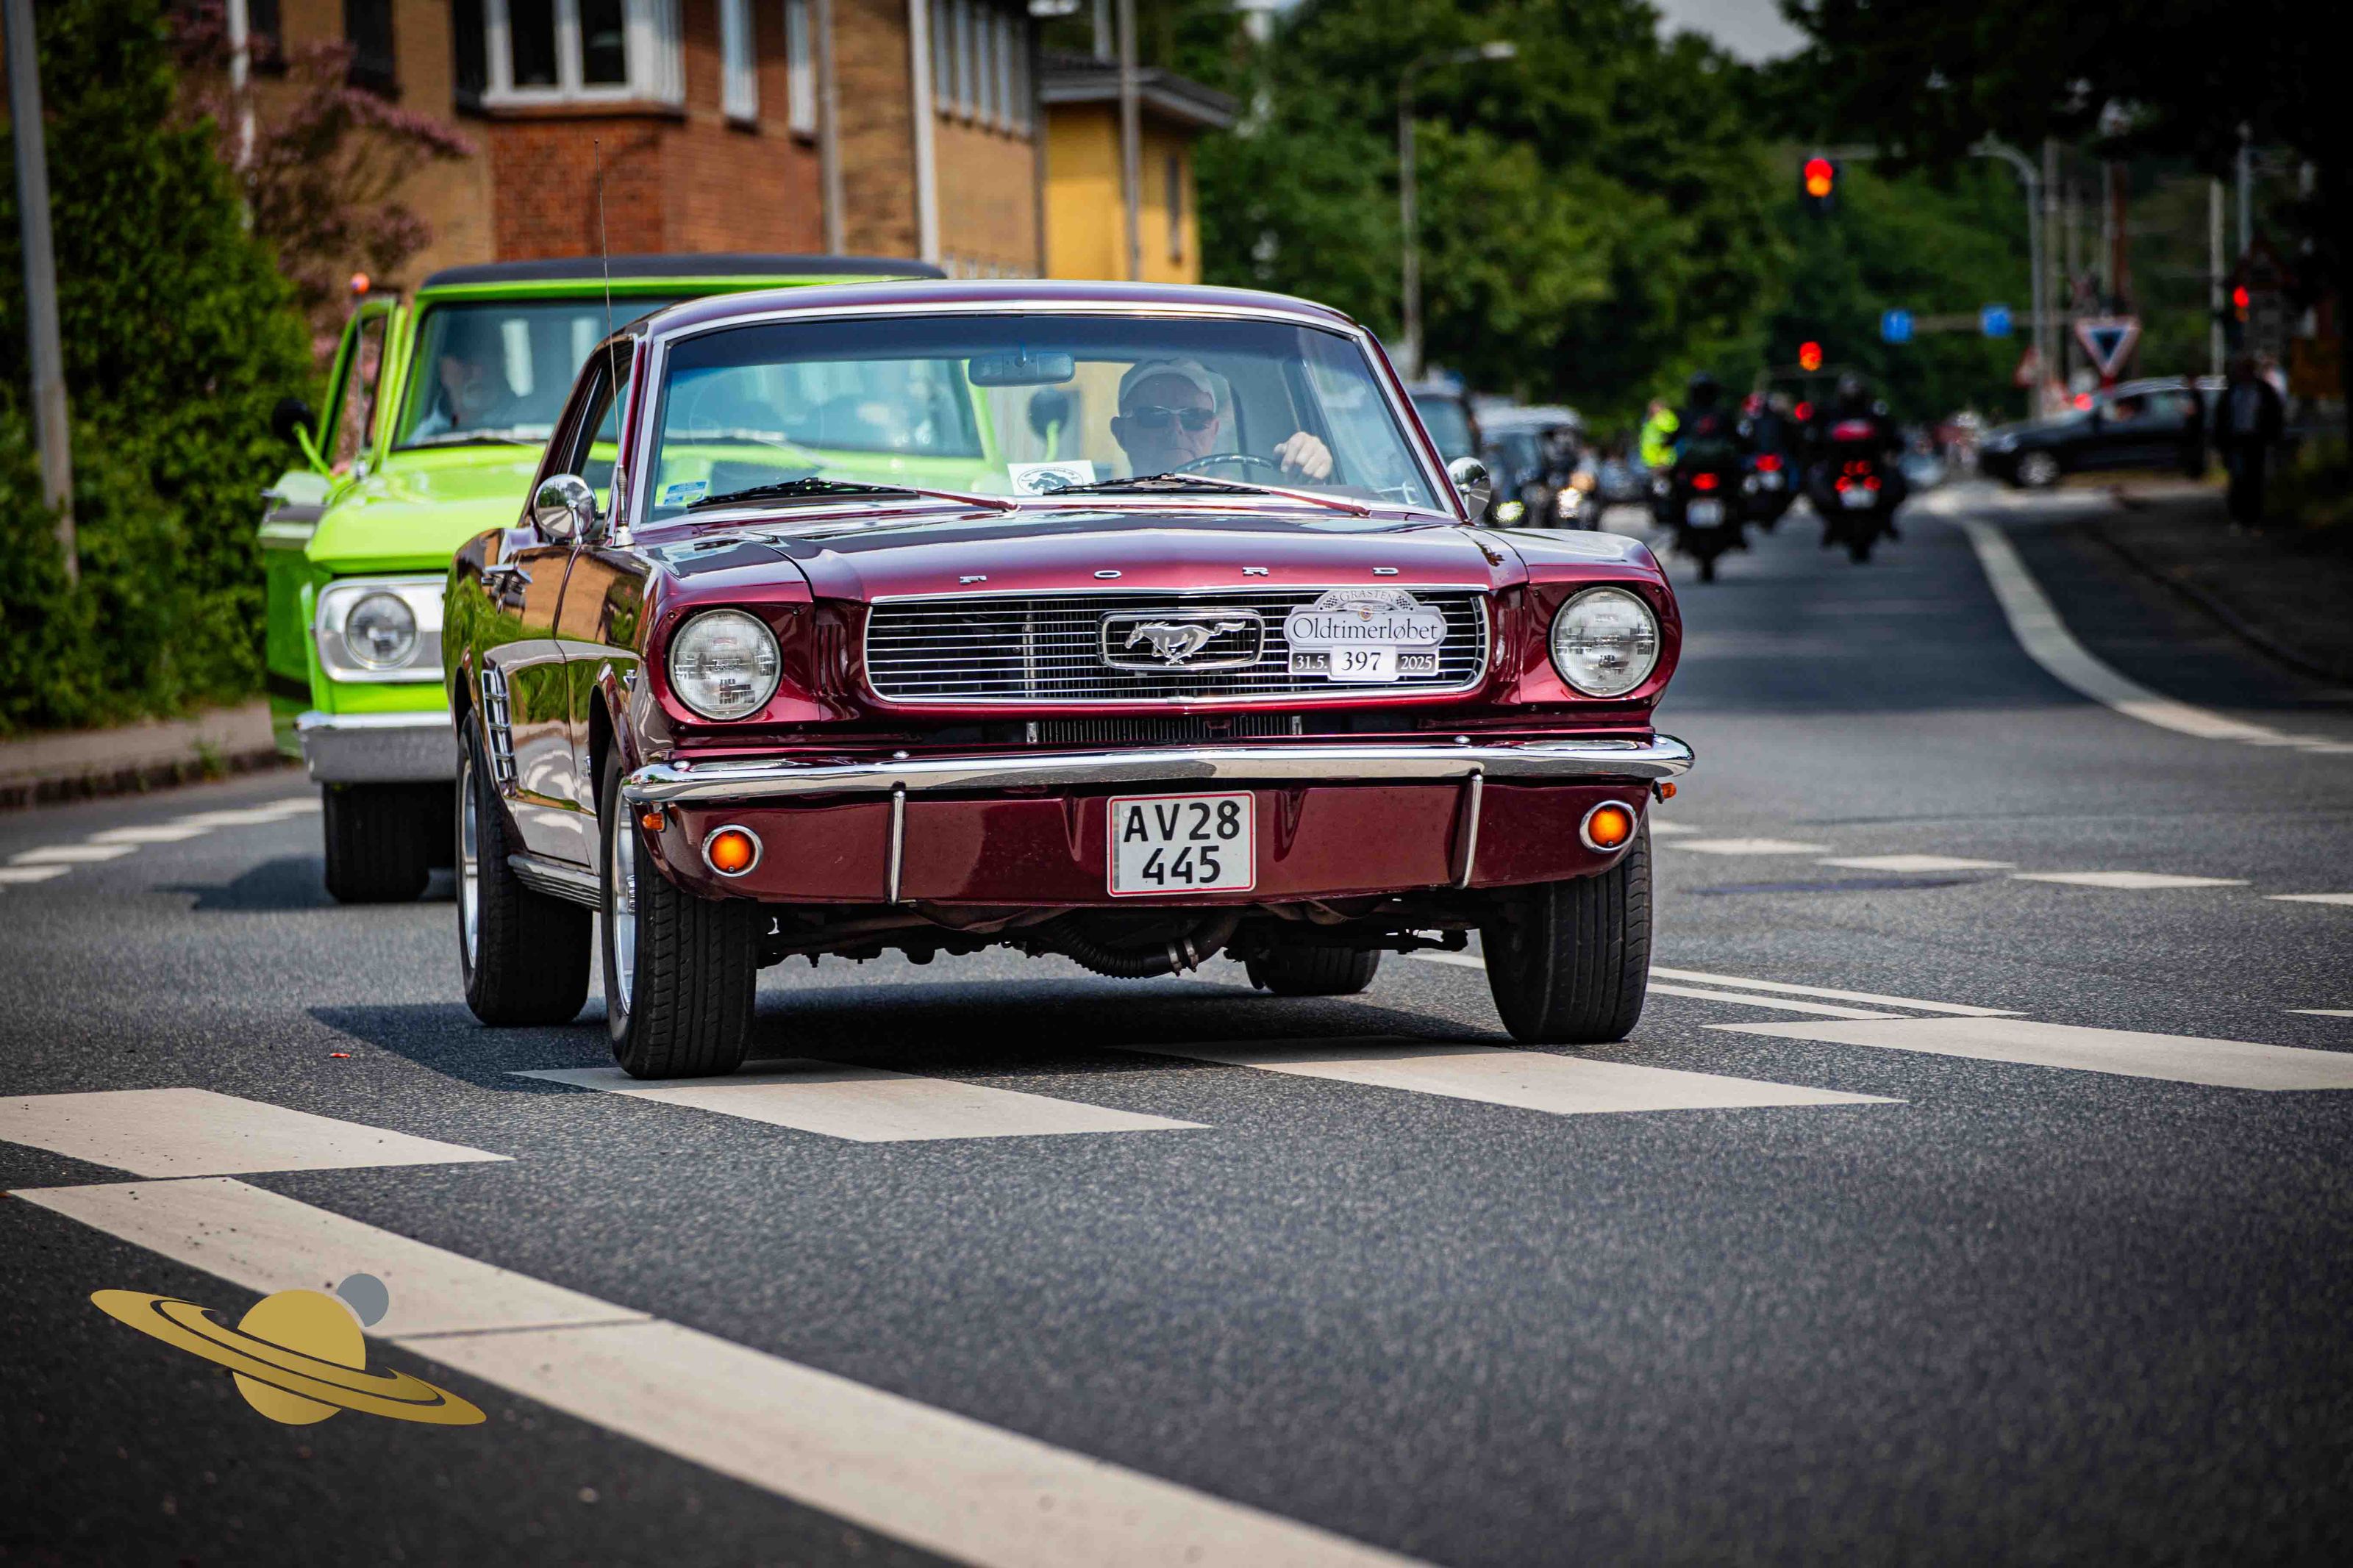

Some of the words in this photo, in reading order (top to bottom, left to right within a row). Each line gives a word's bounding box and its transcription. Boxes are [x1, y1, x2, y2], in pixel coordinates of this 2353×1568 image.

[1293, 617, 1438, 642] Oldtimerløbet
[1340, 651, 1382, 672] 397
[1401, 655, 1433, 670] 2025
[1142, 845, 1221, 885] 445
